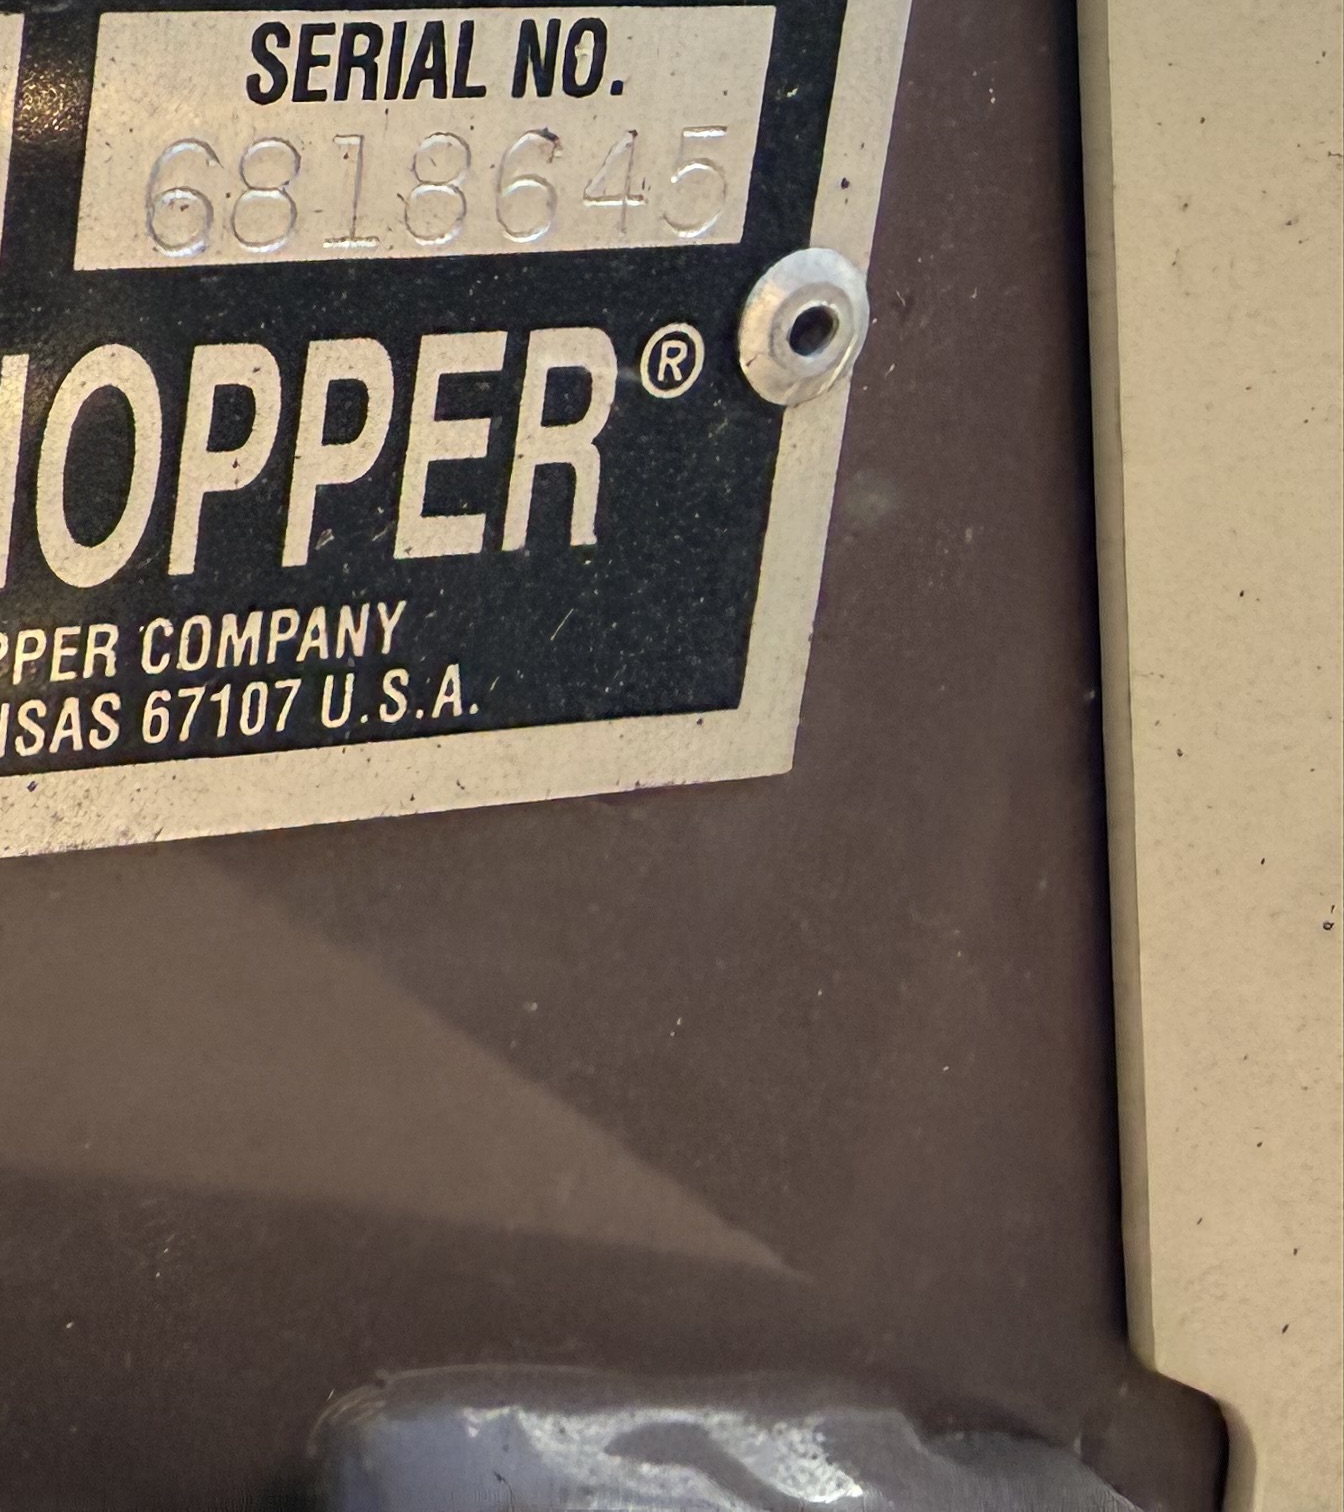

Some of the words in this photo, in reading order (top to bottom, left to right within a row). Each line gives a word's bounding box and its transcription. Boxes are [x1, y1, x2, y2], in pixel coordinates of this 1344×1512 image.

[245, 19, 487, 105] SERIAL
[511, 17, 624, 99] NO.
[144, 124, 730, 258] 6818645
[140, 600, 407, 676] COMPANY
[142, 679, 303, 746] 67107
[320, 664, 480, 729] U.S.A.
